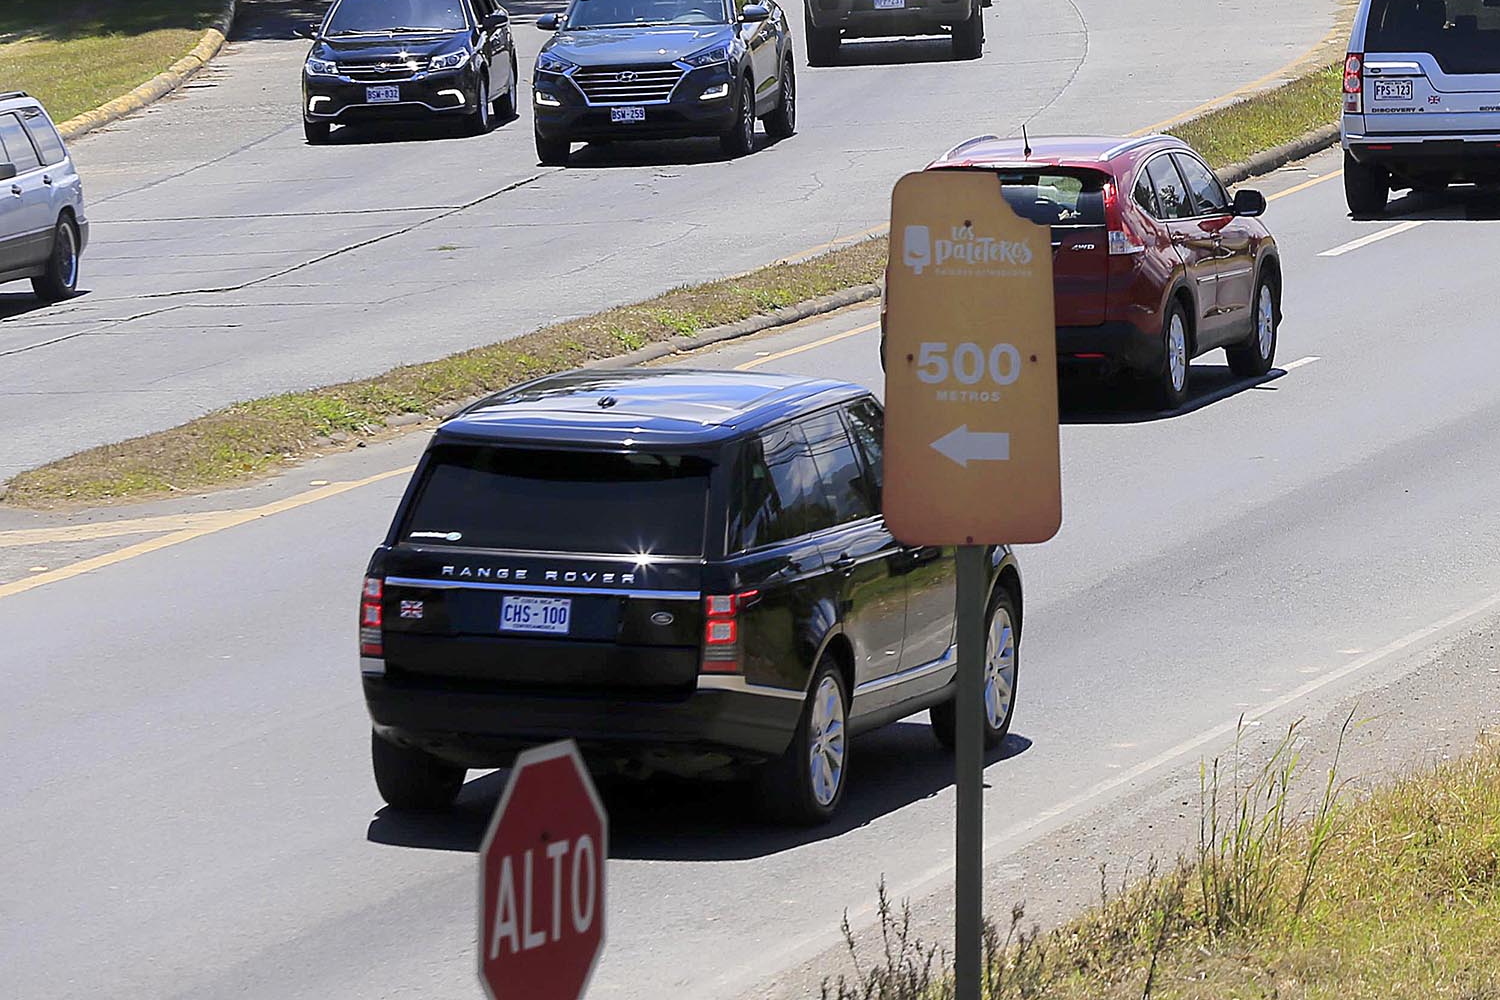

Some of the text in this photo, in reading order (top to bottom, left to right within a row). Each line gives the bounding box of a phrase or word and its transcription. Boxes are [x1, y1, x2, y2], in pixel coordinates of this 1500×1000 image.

[1376, 85, 1411, 96] FPS-123
[916, 342, 1022, 386] 500
[936, 389, 1001, 402] METROS
[441, 565, 636, 584] RANGE ROVER
[504, 604, 567, 625] CHS-100
[489, 834, 597, 960] ALTO
